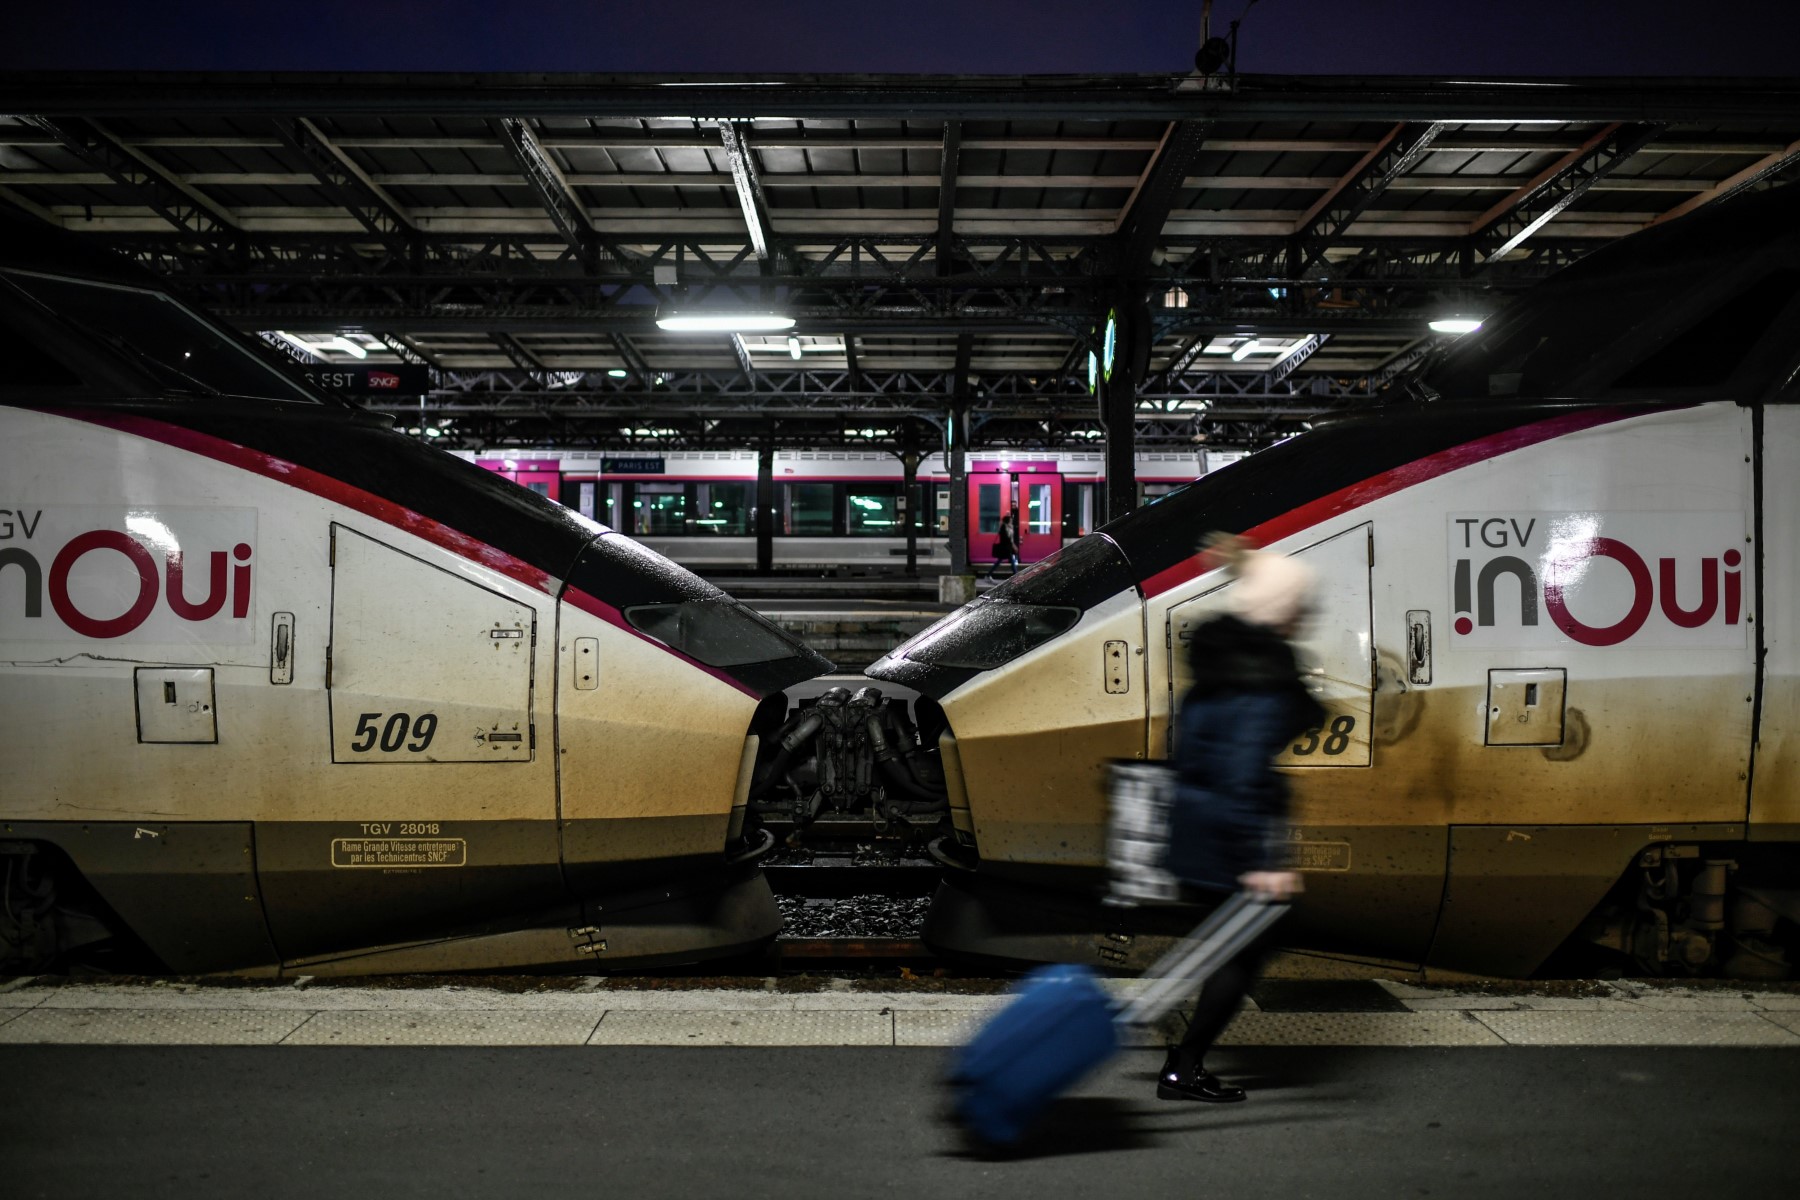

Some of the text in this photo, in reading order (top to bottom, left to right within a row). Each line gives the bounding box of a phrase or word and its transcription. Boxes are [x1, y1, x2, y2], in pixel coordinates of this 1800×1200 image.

[321, 373, 355, 387] EST
[369, 377, 400, 388] SNCF
[618, 462, 660, 470] PARIS EST
[0, 509, 42, 539] GV
[1455, 518, 1536, 548] TGV
[351, 712, 438, 752] 509
[1292, 715, 1356, 756] 38
[361, 823, 440, 835] TGV 28018
[341, 841, 456, 852] Rame Grande Vitesse entretenue
[350, 852, 448, 865] par les Technicentres SNCF
